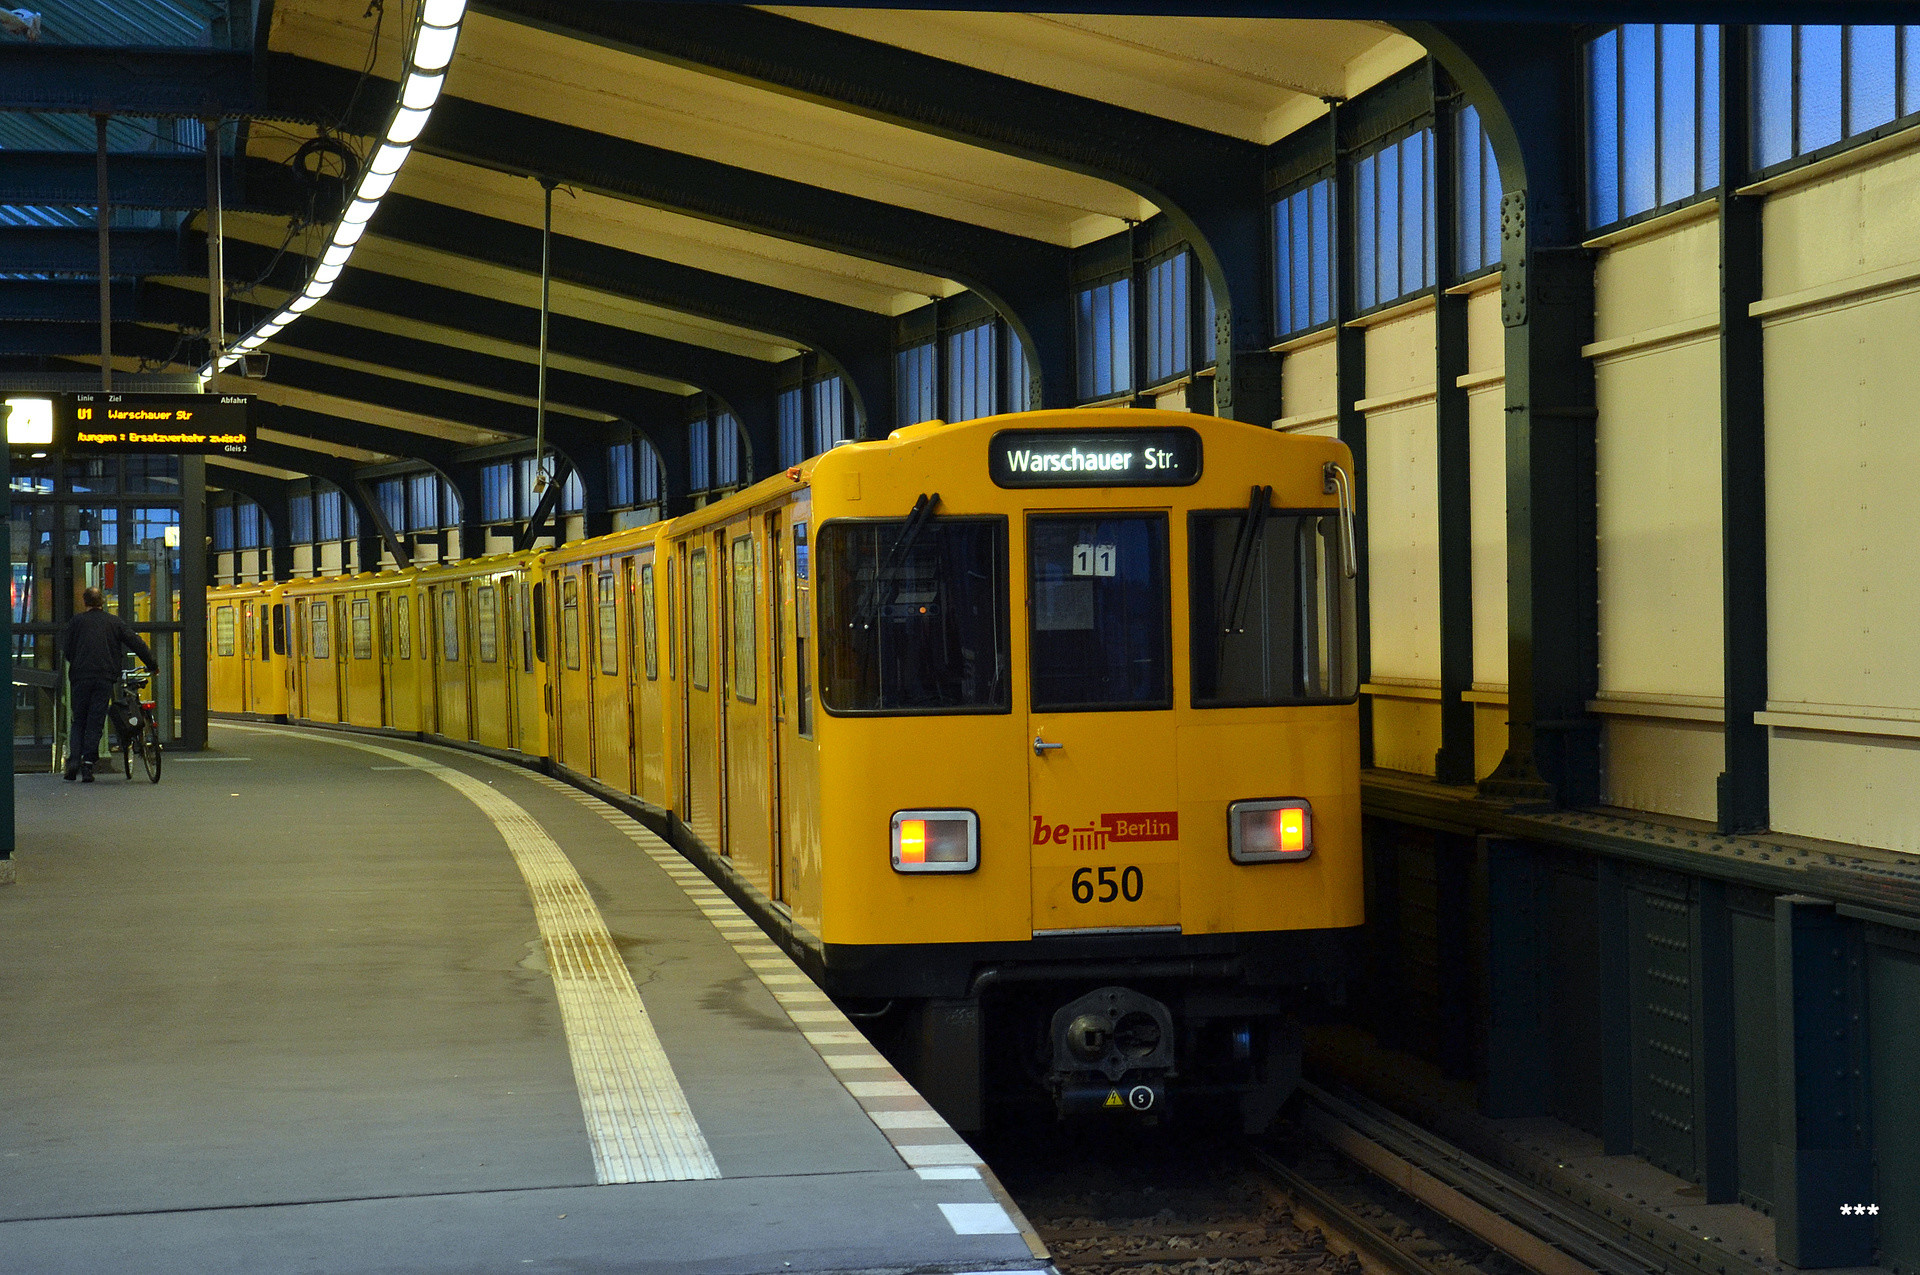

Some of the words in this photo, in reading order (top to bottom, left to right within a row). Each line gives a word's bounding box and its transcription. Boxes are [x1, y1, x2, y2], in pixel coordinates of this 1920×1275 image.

[77, 394, 94, 402] Linie
[220, 396, 247, 404] Abfahrt
[77, 408, 92, 420] U1
[108, 409, 172, 420] Warschauer
[129, 432, 207, 443] Ersatzverkehr
[1007, 447, 1132, 472] Warschauer
[1144, 447, 1179, 470] Str.
[1032, 815, 1070, 845] be
[1116, 819, 1170, 836] Berlin
[1071, 865, 1144, 904] 650
